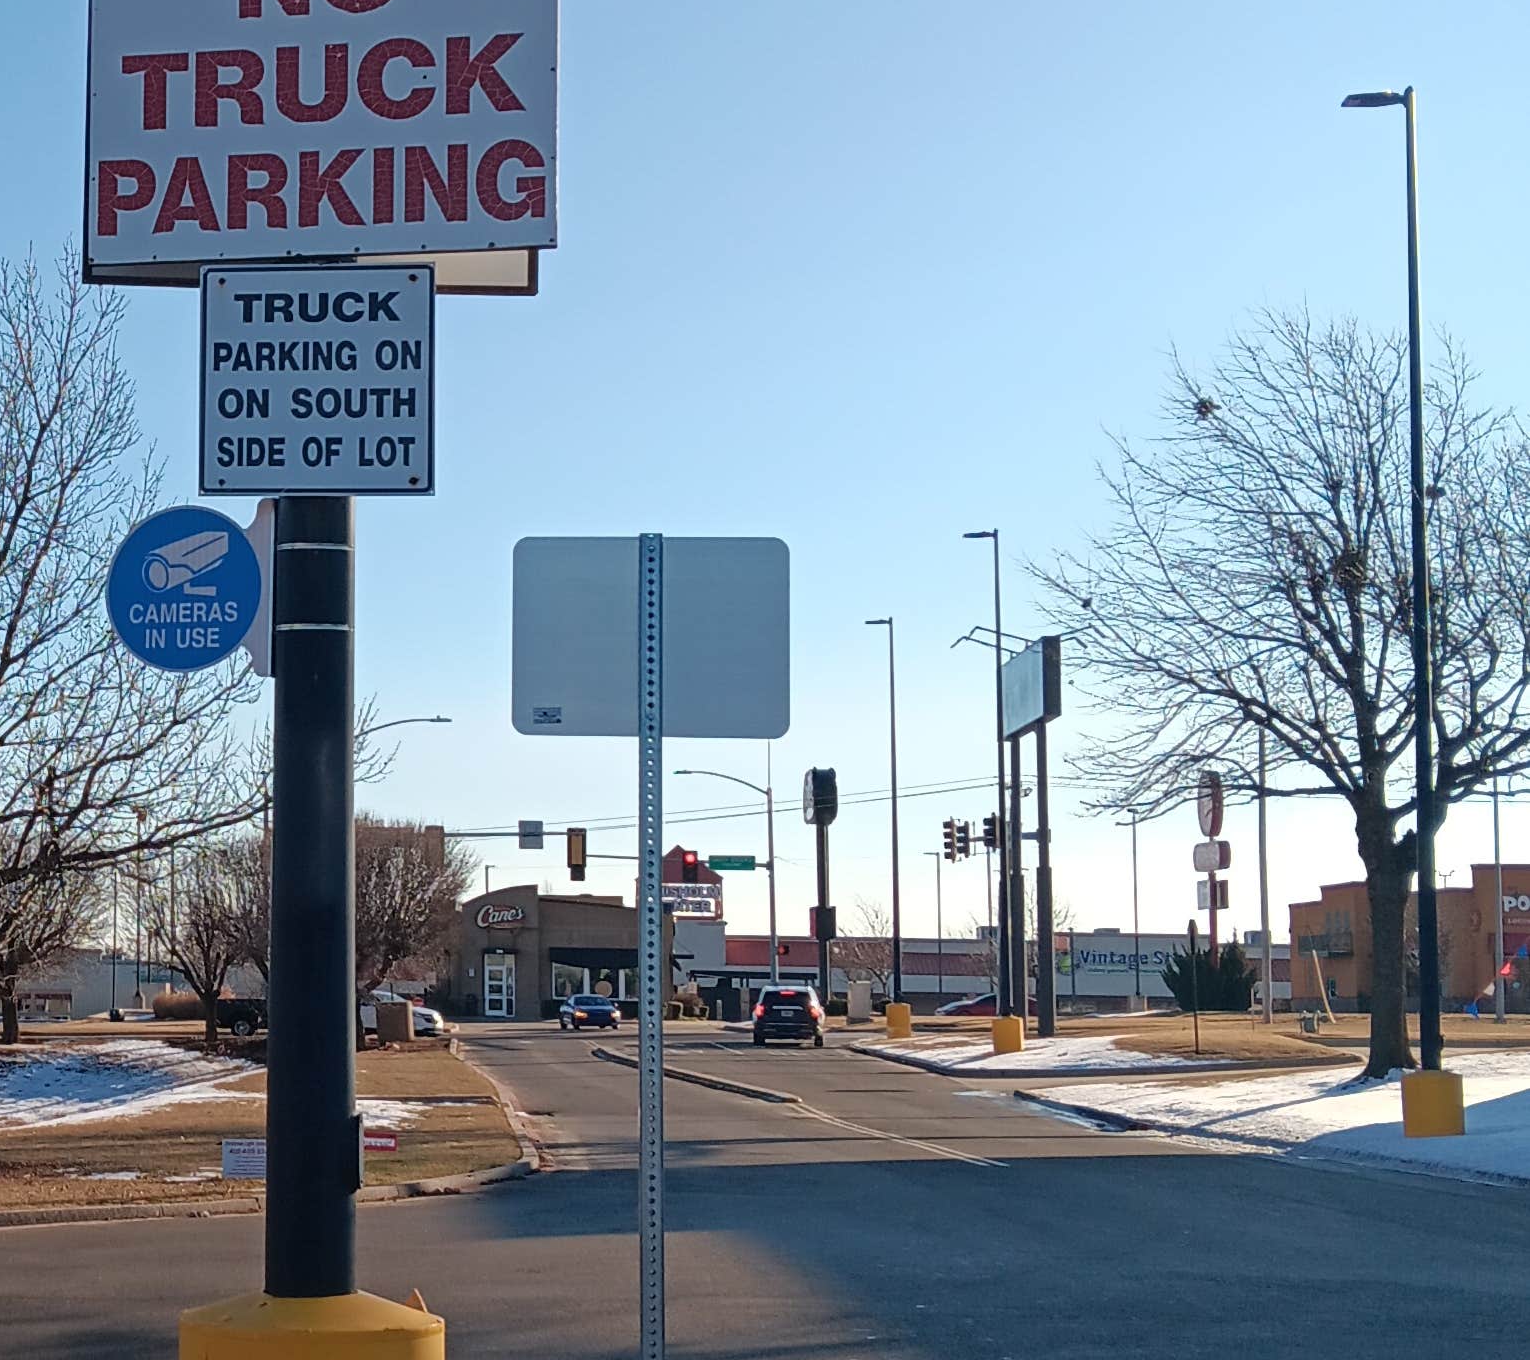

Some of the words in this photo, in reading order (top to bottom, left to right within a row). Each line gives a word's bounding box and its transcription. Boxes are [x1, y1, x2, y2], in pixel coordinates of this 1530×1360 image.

[121, 32, 526, 130] TRUCK
[97, 138, 546, 236] PARKING
[234, 291, 401, 324] TRUCK
[213, 340, 358, 372] PARKING
[375, 339, 422, 370] ON
[217, 388, 269, 419] ON
[290, 387, 416, 418] SOUTH
[216, 437, 286, 468] SIDE
[301, 437, 343, 467] OF
[358, 436, 416, 467] LOT
[130, 601, 238, 624] CAMERAS
[145, 628, 166, 649] IN
[176, 627, 220, 648] USE
[1080, 950, 1148, 969] Vintage
